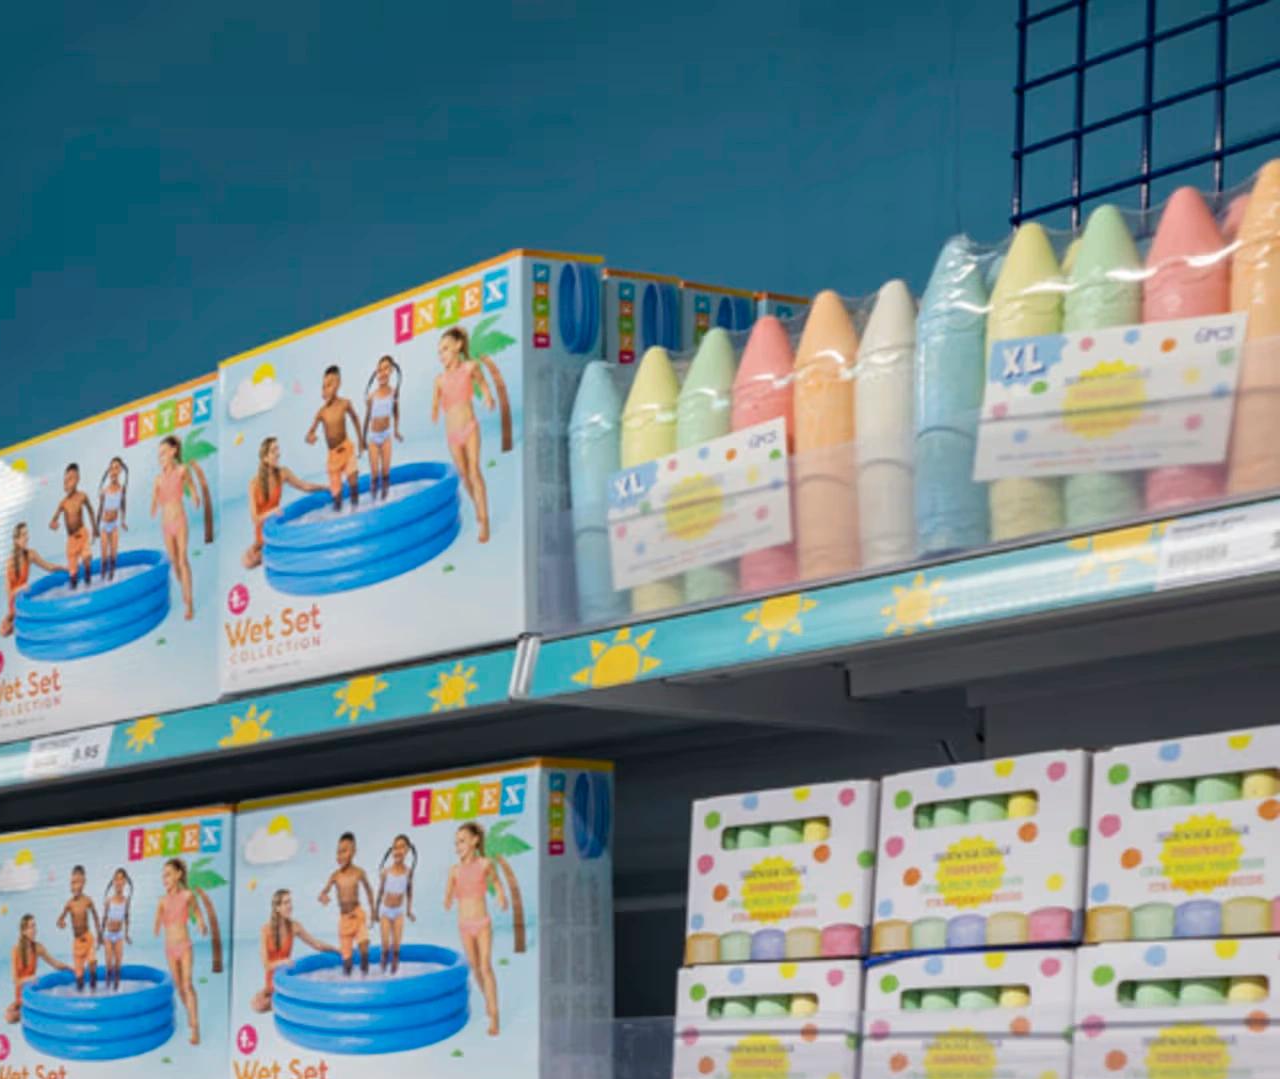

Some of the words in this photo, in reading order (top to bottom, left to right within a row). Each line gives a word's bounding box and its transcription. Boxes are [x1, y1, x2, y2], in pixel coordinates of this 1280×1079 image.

[394, 268, 509, 344] INTEX
[1002, 344, 1047, 379] XL
[124, 388, 213, 447] INTEX
[614, 472, 644, 497] XL
[224, 614, 274, 648] Wet
[280, 604, 322, 637] Set
[27, 668, 62, 697] Set
[412, 774, 527, 826] INTEX
[128, 819, 223, 861] INTEX
